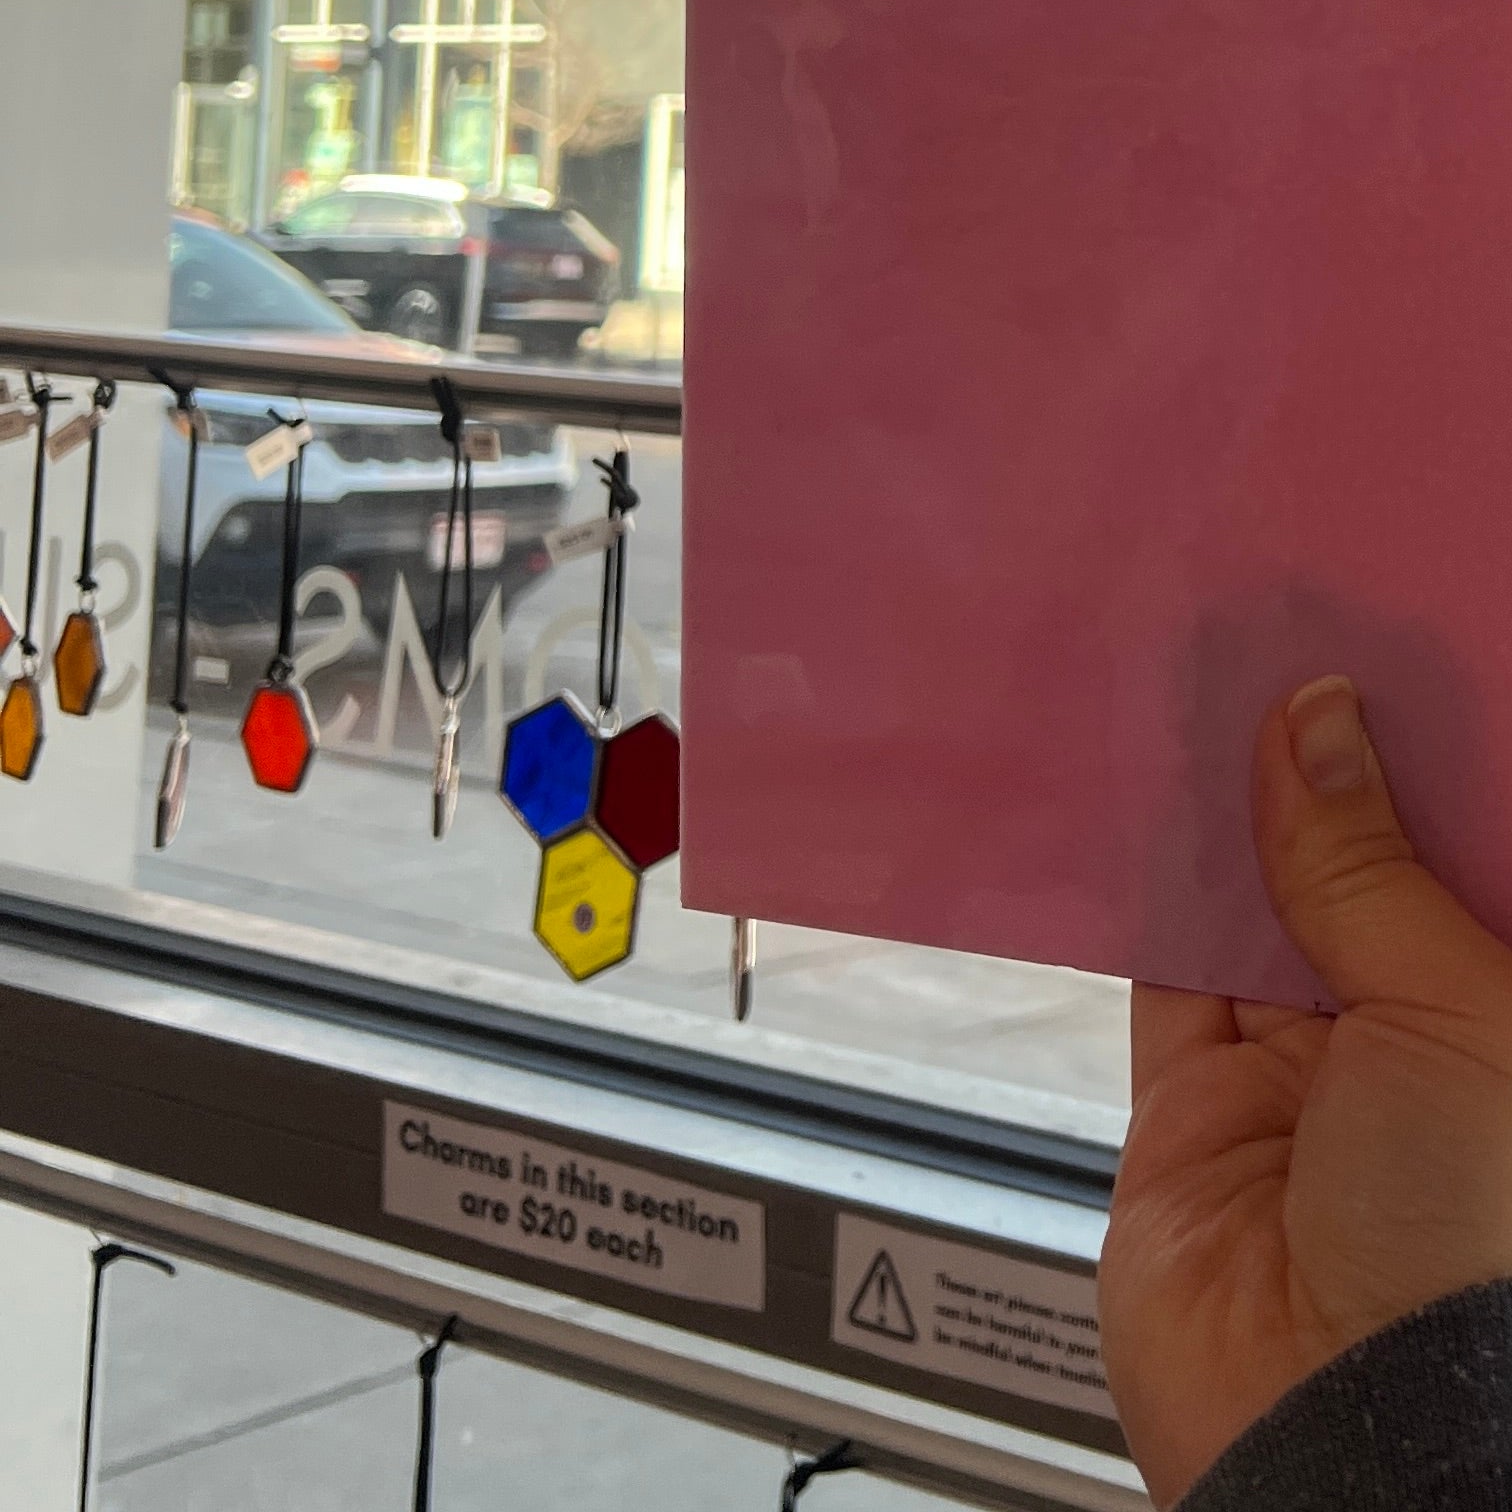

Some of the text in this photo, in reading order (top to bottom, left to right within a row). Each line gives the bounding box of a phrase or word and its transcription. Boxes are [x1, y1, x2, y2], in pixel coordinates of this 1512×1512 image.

[399, 1118, 740, 1245] Charms in this section
[459, 1190, 664, 1270] are $20 each
